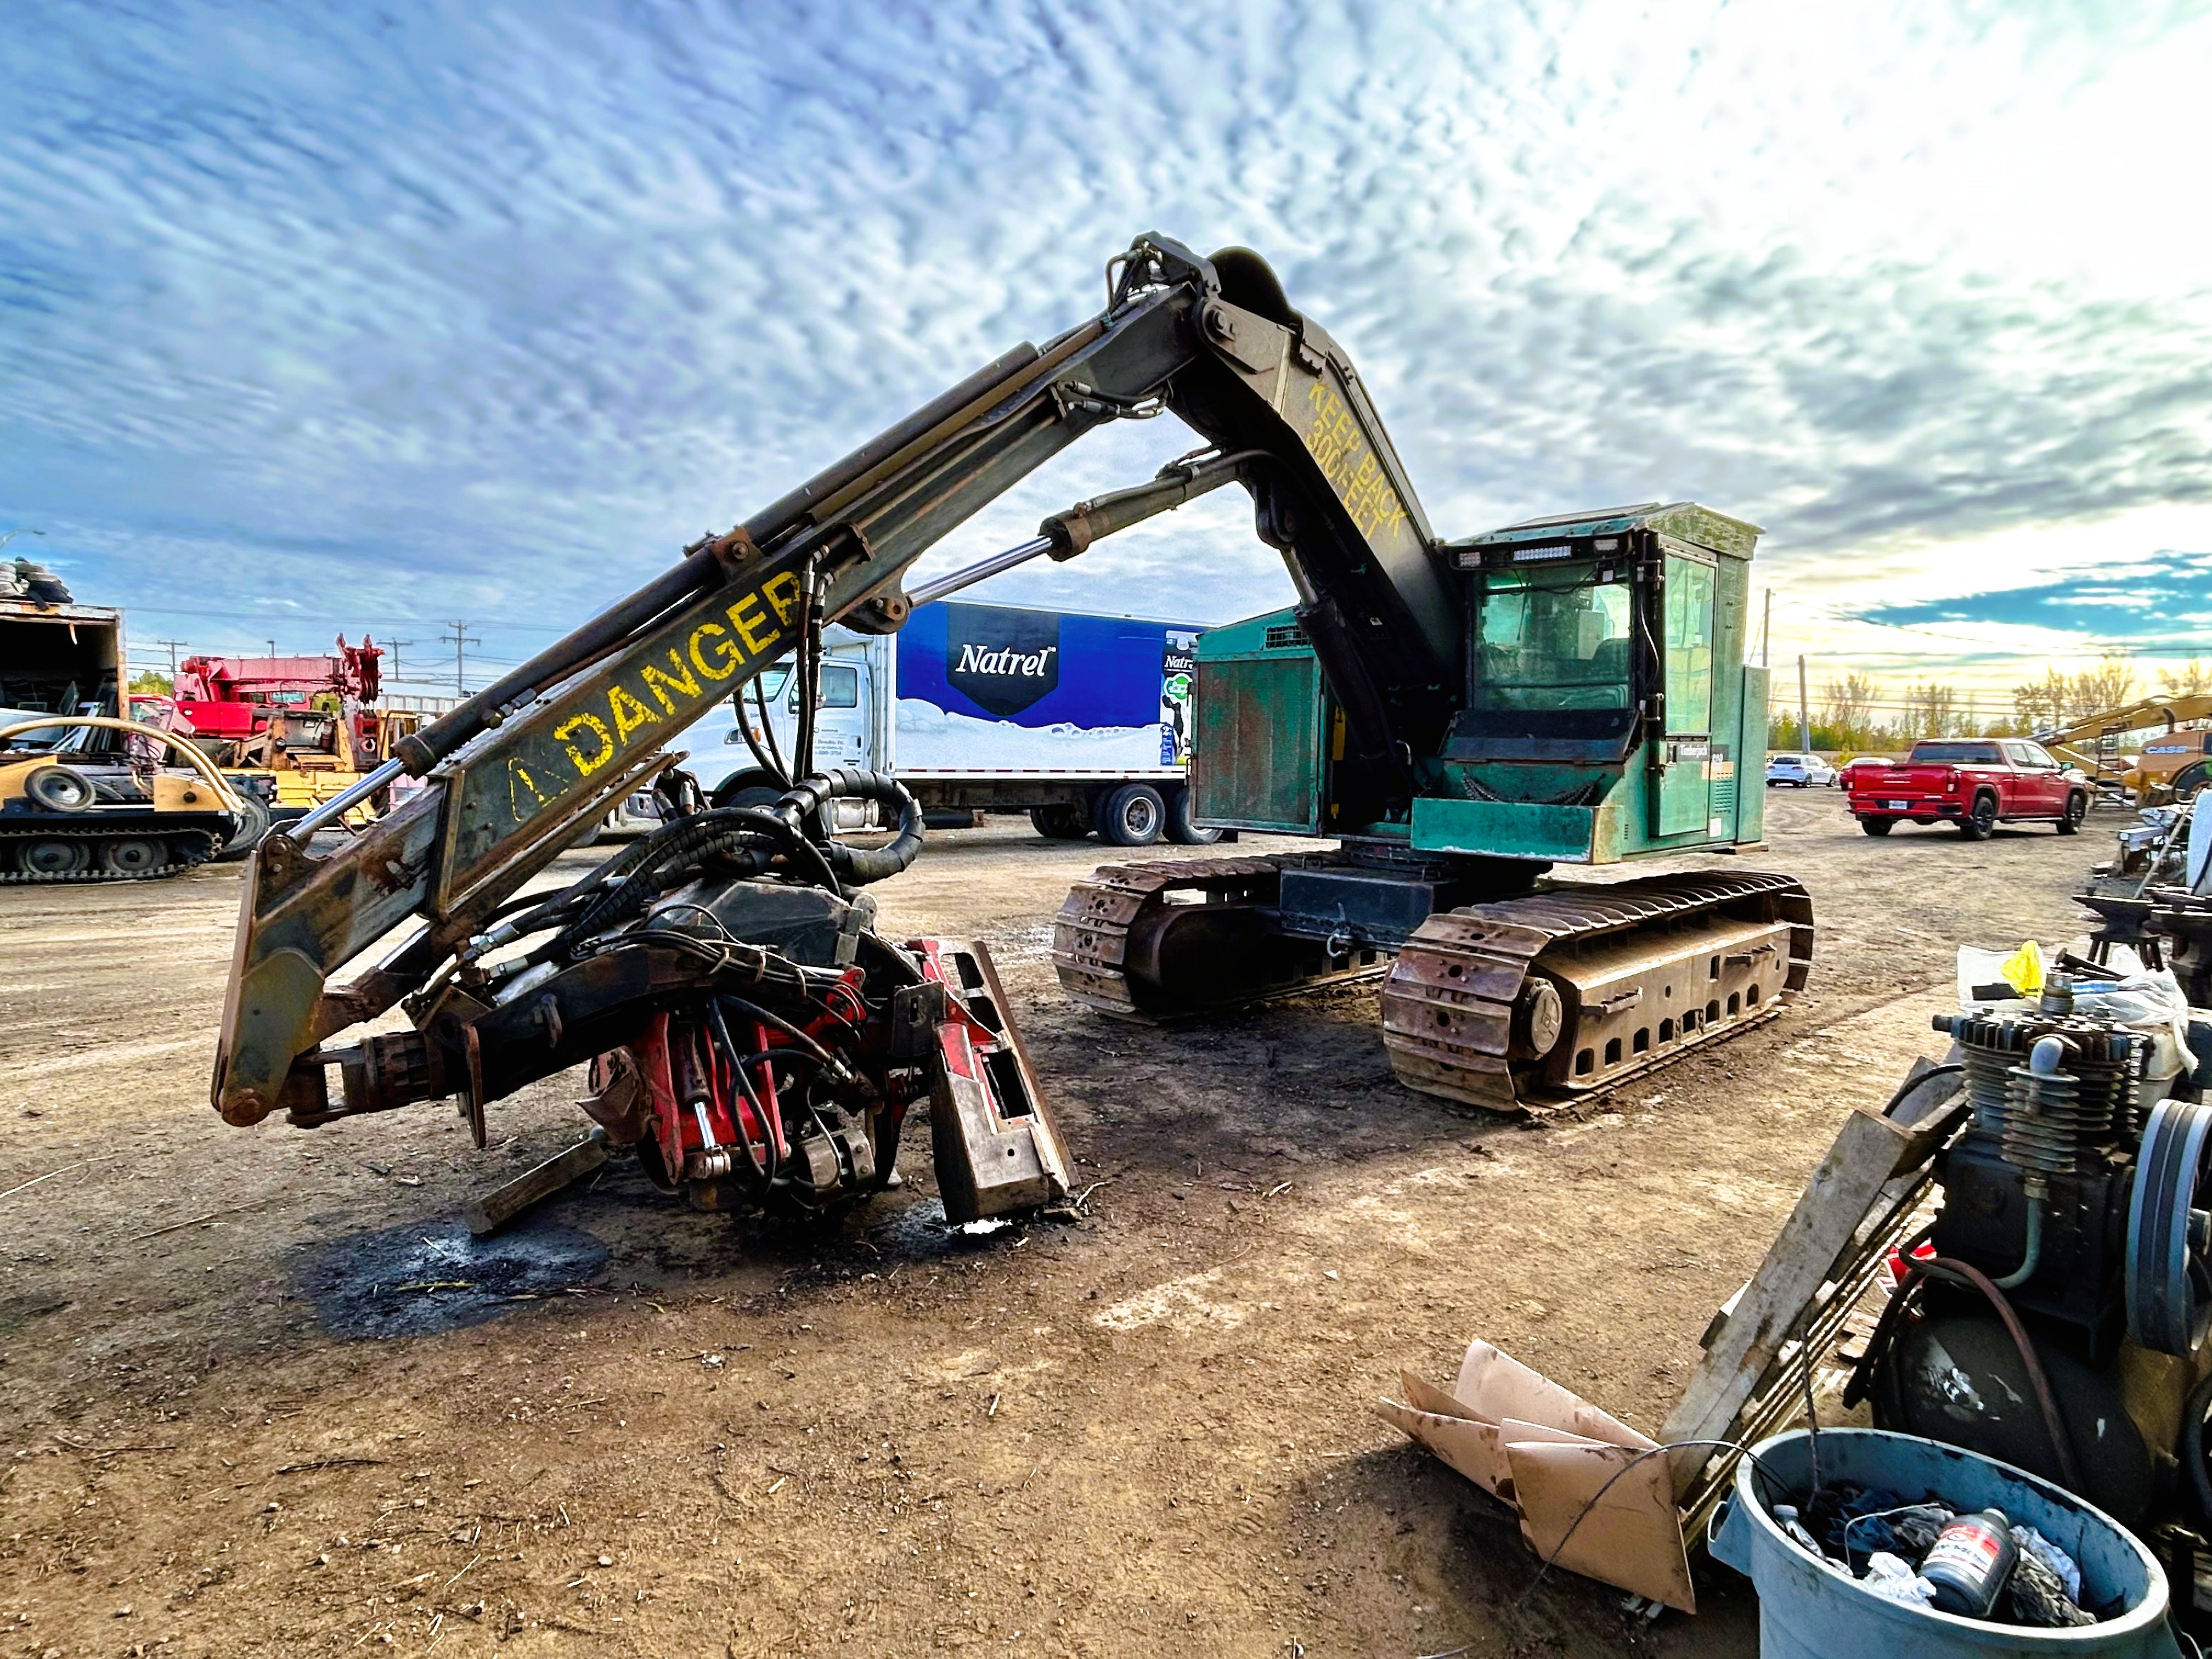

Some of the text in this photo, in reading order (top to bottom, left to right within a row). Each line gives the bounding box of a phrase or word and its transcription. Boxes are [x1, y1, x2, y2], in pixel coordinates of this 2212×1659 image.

[1308, 382, 1408, 538] KEEP BACK
[554, 571, 802, 777] DANGER
[955, 644, 1048, 677] Natrel
[1164, 655, 1193, 669] Natr
[2146, 746, 2188, 754] CASE
